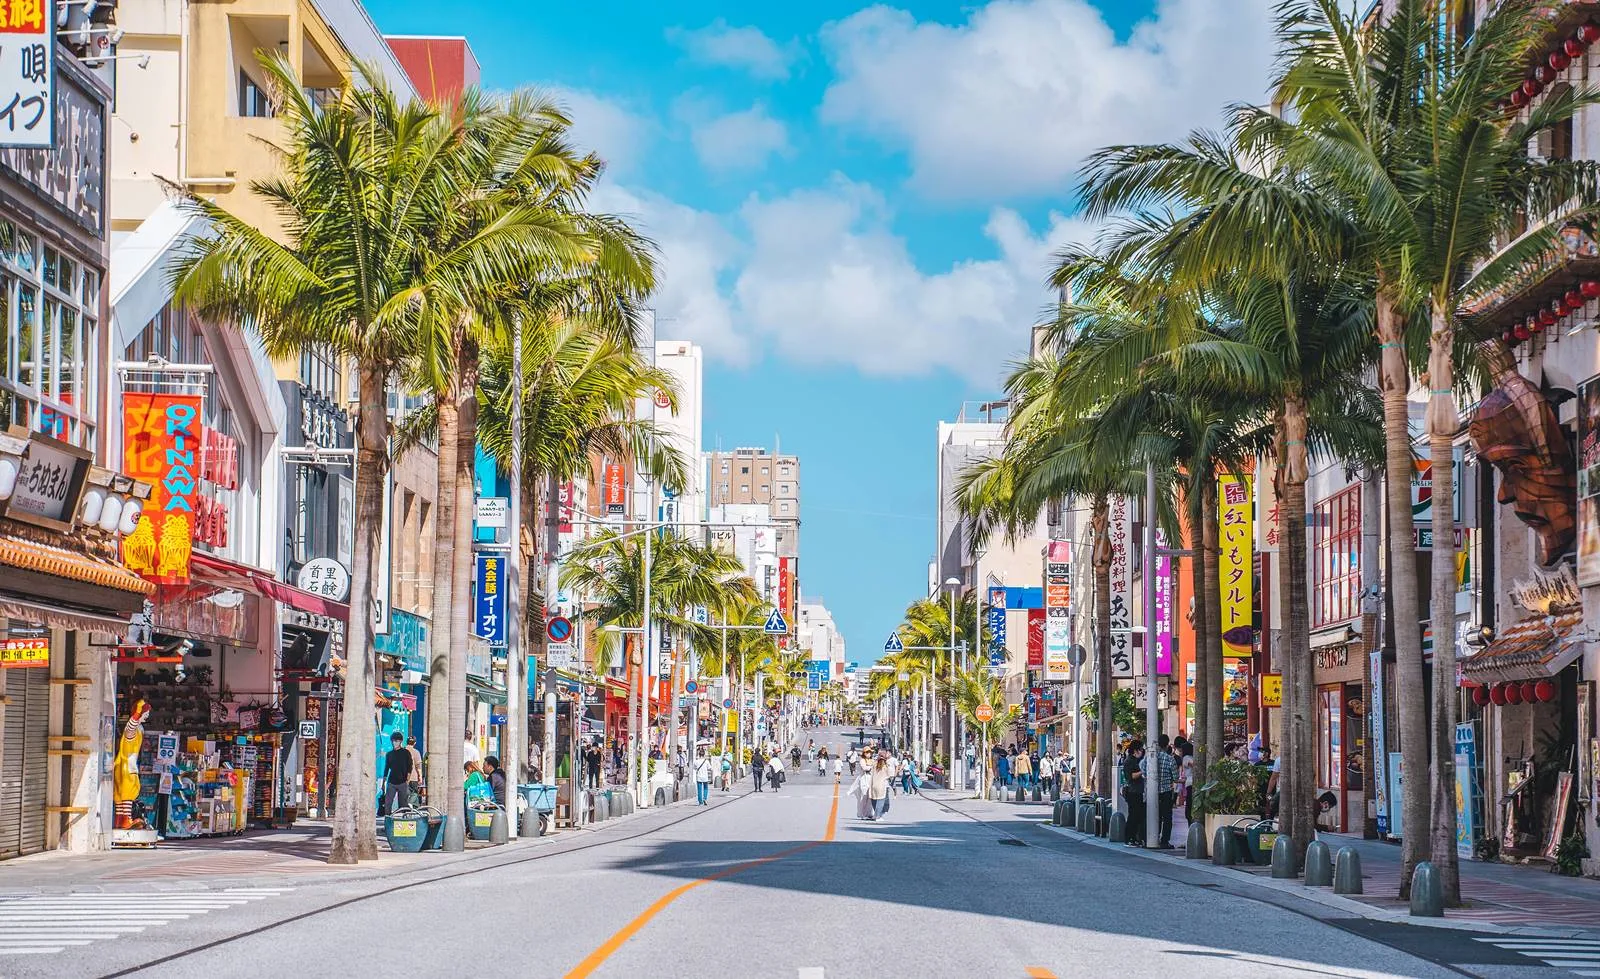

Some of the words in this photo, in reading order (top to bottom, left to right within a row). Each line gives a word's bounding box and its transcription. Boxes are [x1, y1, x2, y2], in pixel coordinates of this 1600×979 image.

[21, 43, 46, 83] 唄
[163, 404, 197, 512] OKINAWA
[28, 459, 69, 502] ちぬまん
[1227, 484, 1246, 504] 元祖
[309, 564, 338, 580] 首里
[485, 558, 498, 595] 英会話
[1223, 508, 1246, 624] 紅いもタルト
[482, 594, 498, 639] イーオン
[1109, 595, 1131, 671] あかはち
